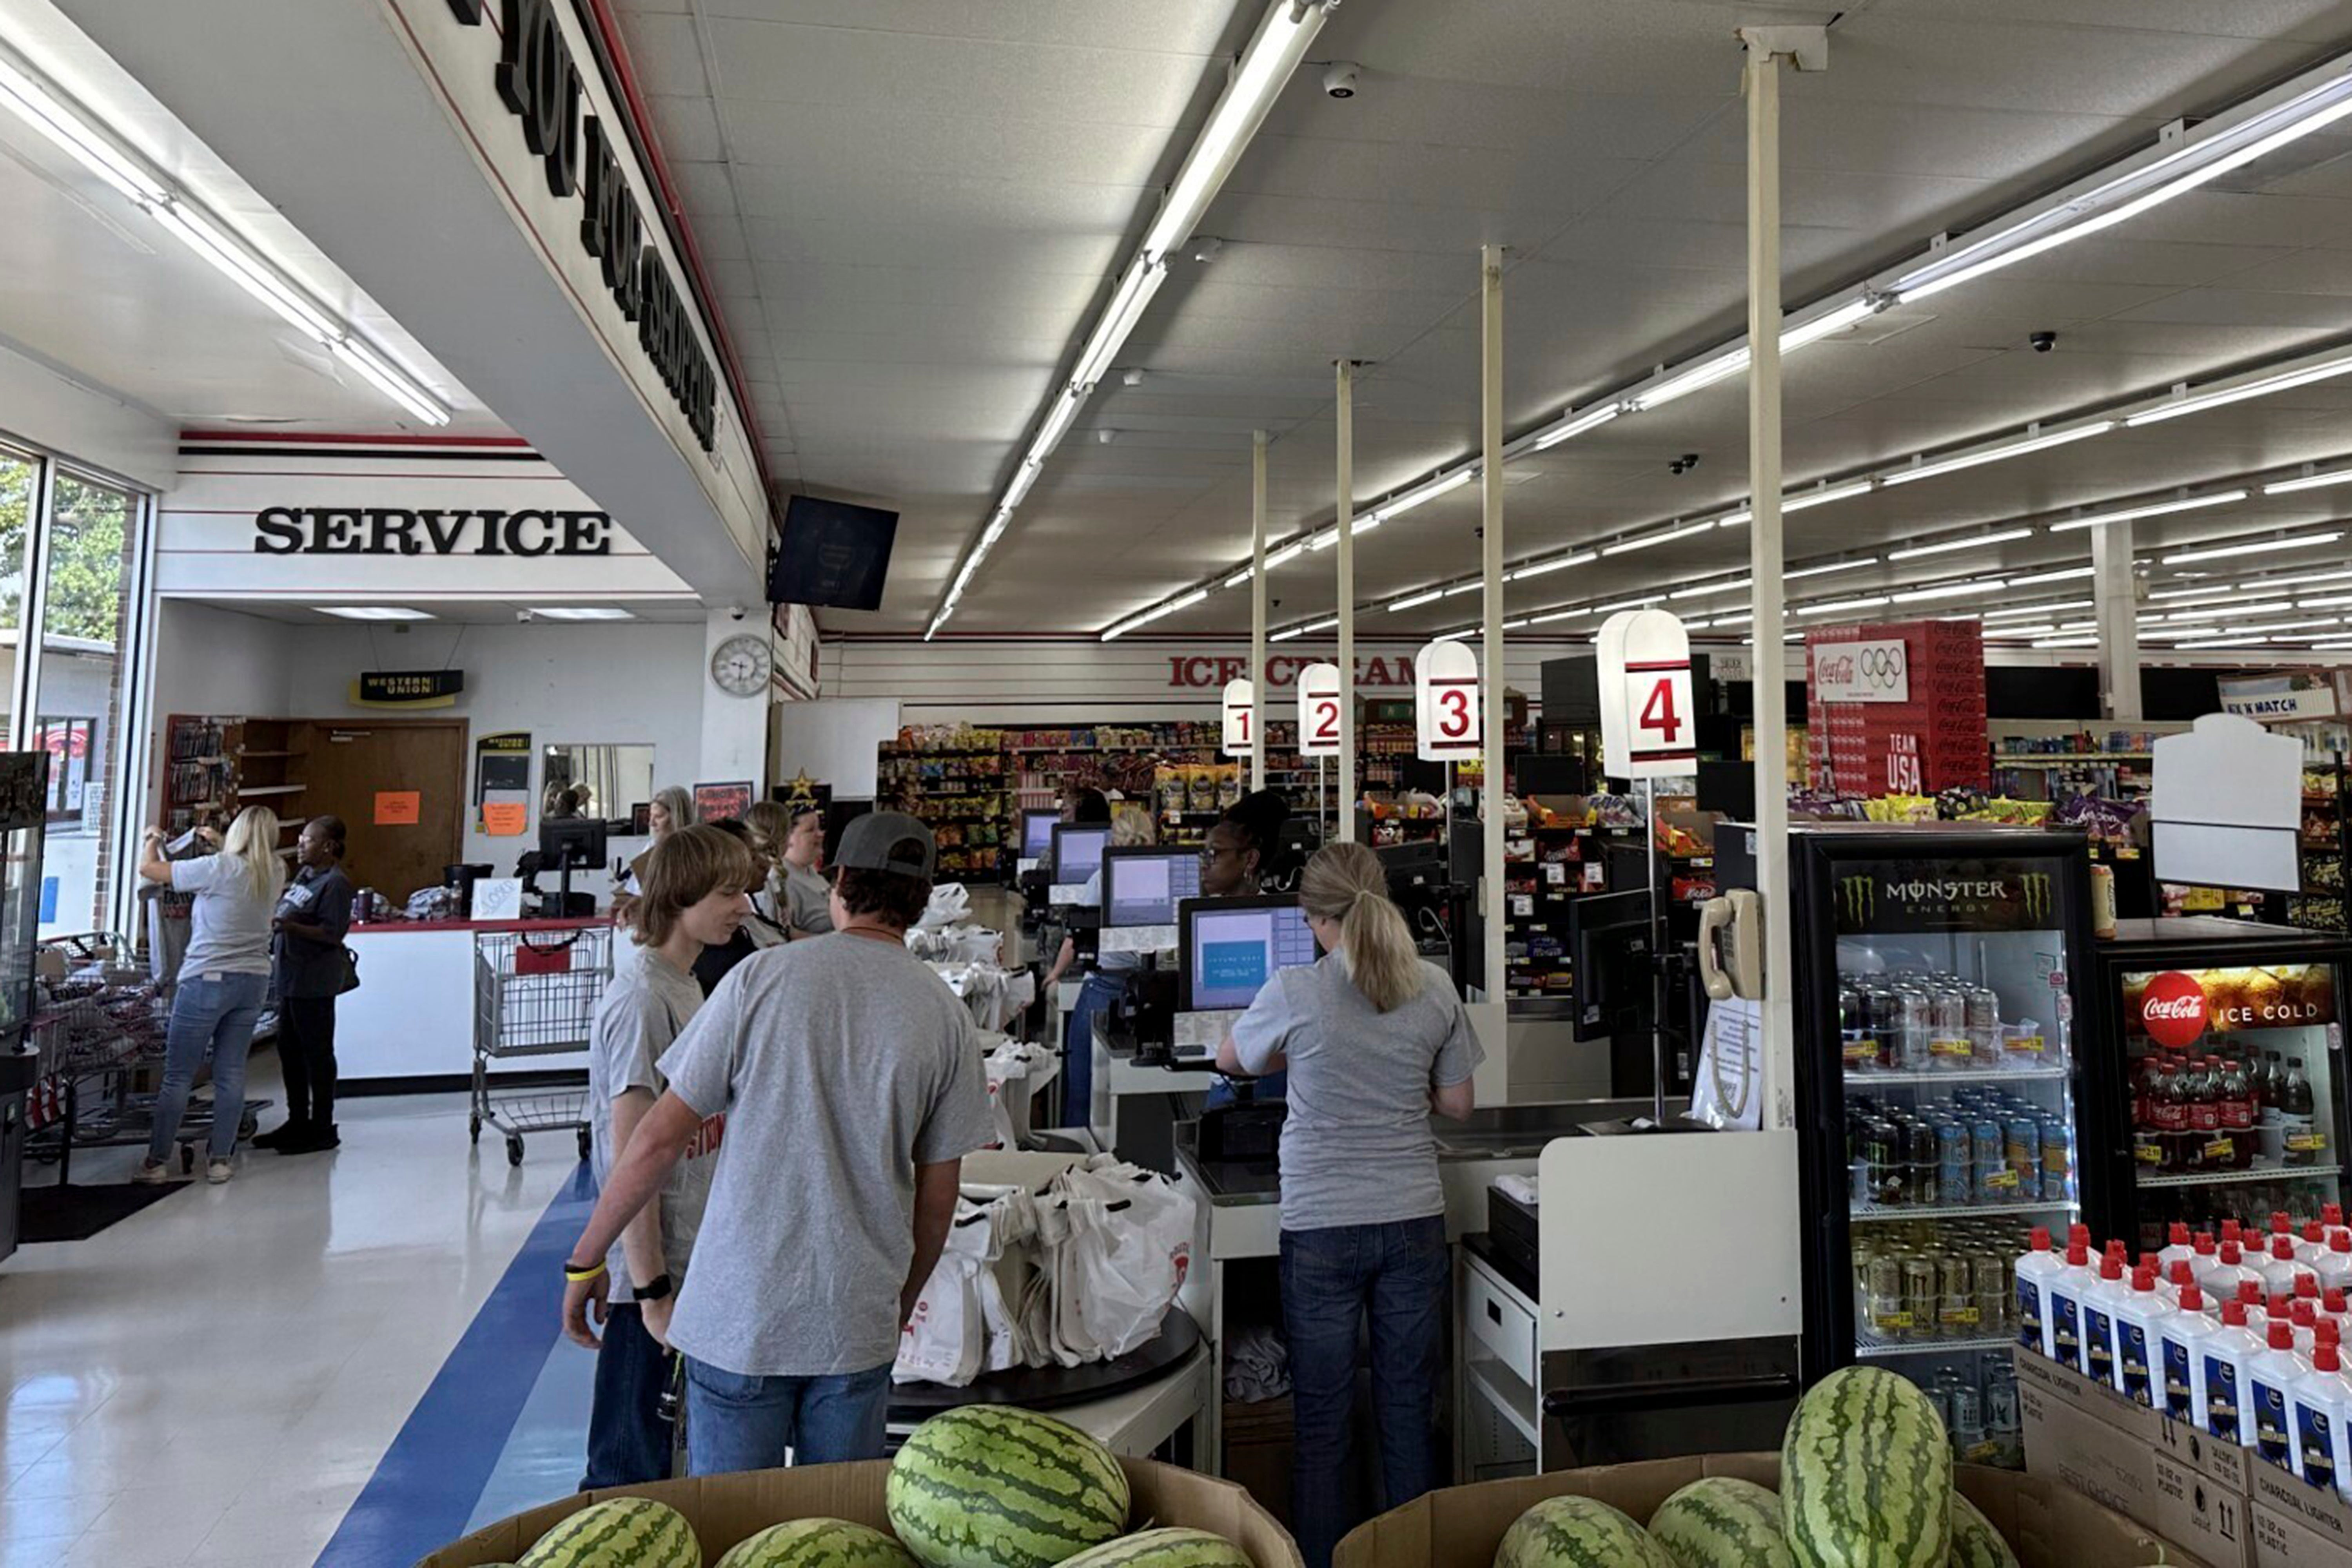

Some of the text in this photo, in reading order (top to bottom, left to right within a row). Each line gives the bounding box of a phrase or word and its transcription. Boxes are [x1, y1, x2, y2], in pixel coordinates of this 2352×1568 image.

[255, 507, 610, 557] SERVICE
[368, 677, 430, 687] WESTERN
[1818, 656, 1853, 685] Coca-Cola
[387, 685, 430, 694] UNION
[1439, 690, 1470, 737] 3
[1640, 678, 1681, 743] 4
[2254, 698, 2298, 713] MATCH
[1236, 712, 1249, 741] 1
[1316, 702, 1339, 738] 2
[1890, 734, 1916, 752] TEAM
[1887, 755, 1922, 794] USA
[1886, 879, 2008, 902] MONSTER
[1906, 904, 1990, 914] ENERGY
[2143, 995, 2203, 1021] Coca-Cola
[2219, 1003, 2318, 1022] ICE COLD
[2259, 1477, 2344, 1534] CHARCOAL LIGHTER
[2258, 1531, 2289, 1557] PLASTIC
